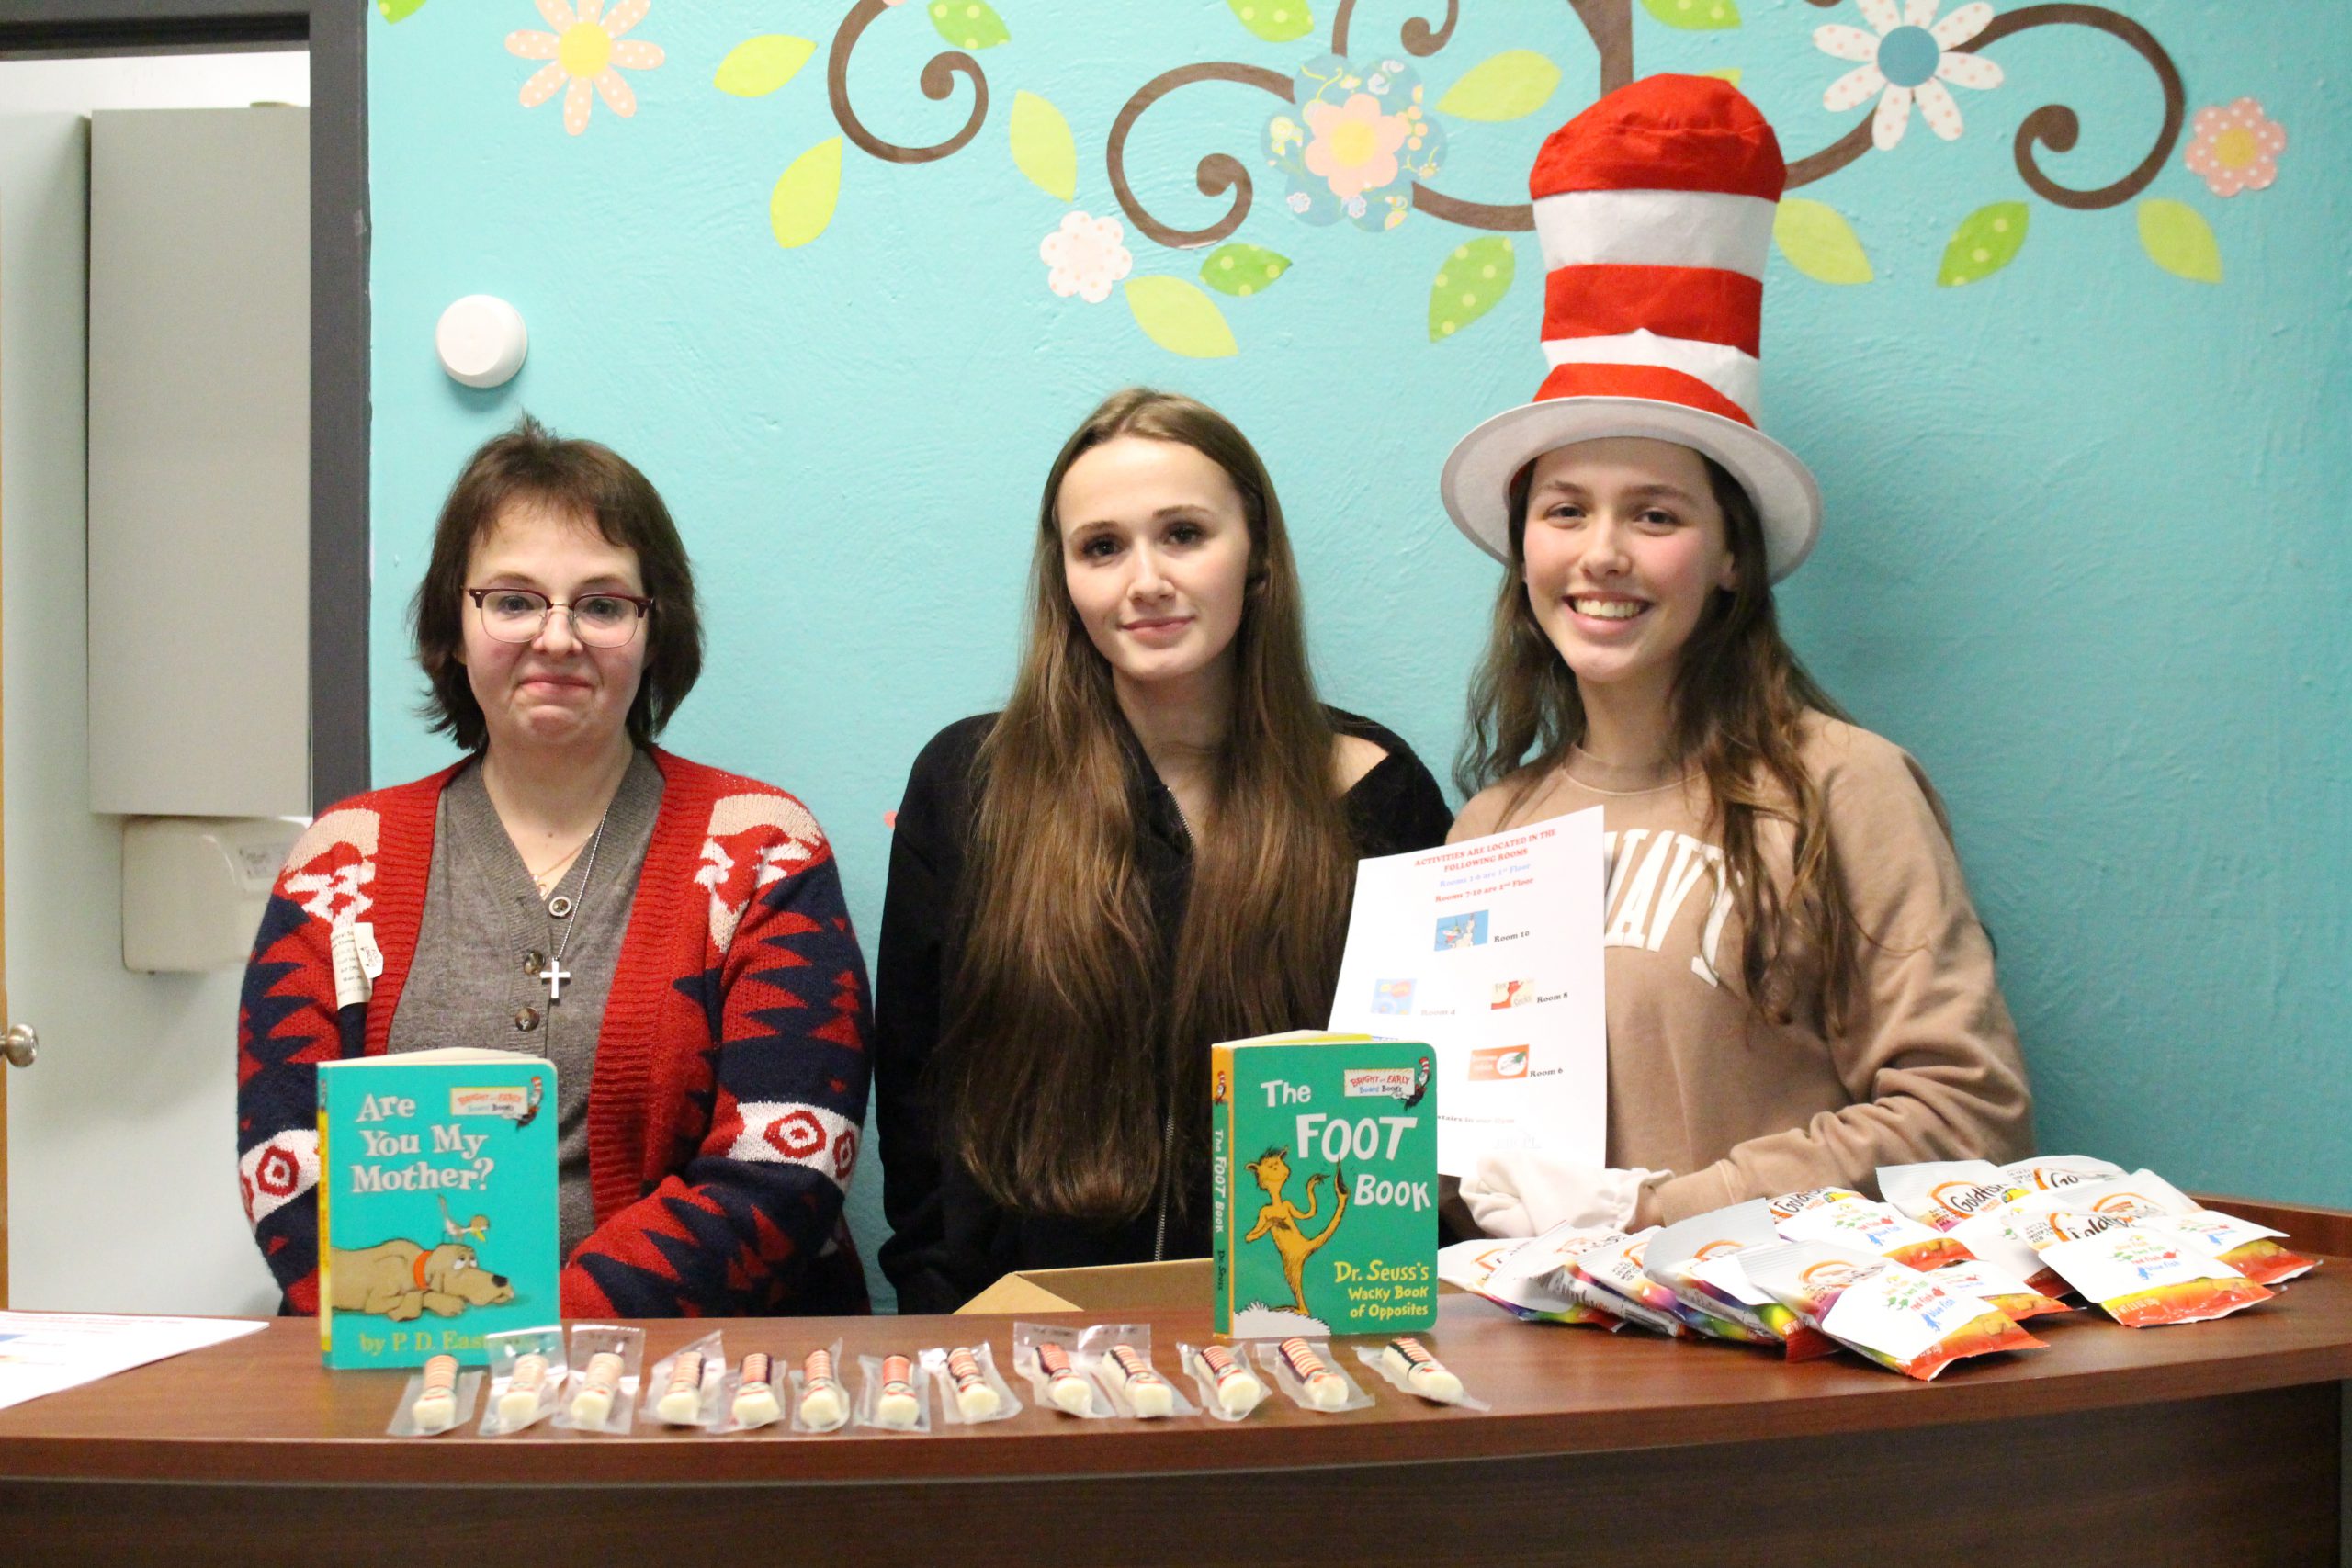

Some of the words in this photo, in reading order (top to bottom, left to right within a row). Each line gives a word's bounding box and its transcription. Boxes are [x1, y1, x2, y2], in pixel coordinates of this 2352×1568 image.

[1414, 852, 1465, 867] ACTIVITIES
[1467, 846, 1485, 858] ARE
[1487, 837, 1527, 852] LOCATED
[1529, 835, 1538, 843] IN
[1540, 829, 1556, 840] THE
[1444, 855, 1497, 873] FOLLOWING
[1498, 848, 1529, 861] ROOMS
[1440, 876, 1467, 888] Rooms
[1483, 871, 1496, 880] are
[1510, 863, 1531, 874] Floor
[1435, 893, 1464, 903] Rooms
[1465, 888, 1482, 898] 7-10
[1484, 886, 1498, 895] are
[1512, 877, 1534, 888] Floor
[1494, 931, 1519, 943] Room
[1520, 931, 1531, 939] 10
[1536, 993, 1561, 1004] Room
[1350, 1075, 1381, 1088] BRIGHT
[1386, 1074, 1411, 1086] EARLY
[1530, 1068, 1557, 1078] Room
[1557, 1067, 1564, 1076] 6
[1261, 1079, 1312, 1108] The
[1381, 1084, 1403, 1093] Books
[356, 1093, 417, 1123] Are
[1437, 1114, 1463, 1122] stairs
[359, 1129, 421, 1157] You
[430, 1123, 490, 1161] My
[1214, 1129, 1224, 1151] The
[1295, 1112, 1418, 1163] FOOT
[350, 1157, 495, 1194] Mother?
[1214, 1154, 1228, 1199] FOOT
[1353, 1173, 1431, 1212] BOOK
[1334, 1260, 1363, 1284] Dr.
[1366, 1259, 1430, 1282] Seuss's
[1348, 1287, 1391, 1303] Wacky
[1395, 1285, 1430, 1300] Book
[1350, 1303, 1365, 1318] of
[1368, 1303, 1430, 1321] Opposites
[359, 1333, 386, 1357] by
[392, 1331, 408, 1353] P.
[414, 1331, 436, 1351] D.
